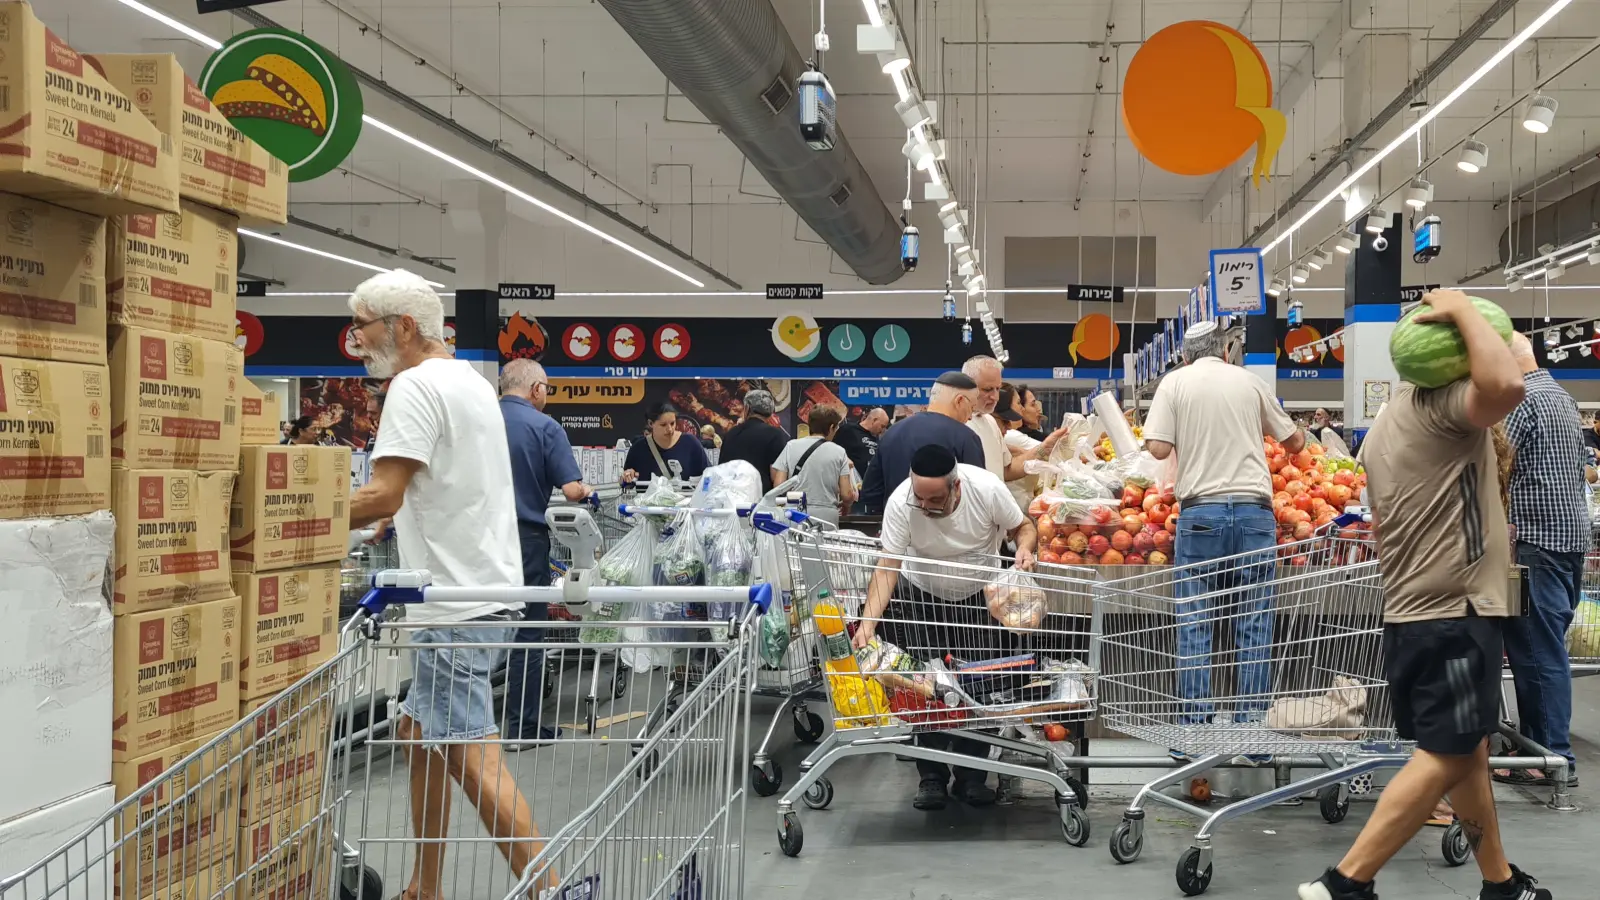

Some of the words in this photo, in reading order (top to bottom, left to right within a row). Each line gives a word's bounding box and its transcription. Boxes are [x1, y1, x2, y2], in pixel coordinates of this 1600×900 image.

[45, 70, 72, 92] מתוק
[77, 82, 101, 102] תירס
[46, 90, 69, 107] Sweet
[72, 98, 88, 114] Corn
[91, 105, 116, 123] Kernels
[105, 94, 131, 113] גרעיני
[183, 110, 202, 126] מתוק
[63, 119, 75, 138] 24
[204, 118, 222, 134] תירס
[182, 125, 199, 140] Sweet
[200, 132, 213, 145] Corn
[193, 148, 202, 164] 24
[127, 239, 147, 255] מתוק
[150, 245, 166, 259] תירס
[169, 250, 189, 264] גרעיני
[126, 255, 145, 267] Sweet
[146, 258, 158, 270] Corn
[159, 262, 177, 275] Kernels
[1219, 262, 1253, 274] רימון
[141, 277, 149, 293] 24
[1231, 276, 1244, 290] 5
[501, 287, 530, 297] האש
[535, 286, 551, 297] על
[768, 287, 796, 298] קפואים
[799, 287, 820, 298] ירקות
[1079, 289, 1112, 299] פירות
[605, 367, 623, 376] טרי
[628, 367, 647, 378] עוף
[139, 382, 159, 396] מתוק
[162, 384, 179, 396] תירס
[181, 387, 200, 398] גרעיני
[562, 386, 590, 398] עוף
[596, 386, 632, 396] נתחי
[848, 386, 891, 398] טריים
[896, 386, 931, 398] דגים
[139, 399, 156, 409] Sweet
[158, 399, 170, 409] Corn
[171, 400, 189, 411] Kernels
[28, 420, 54, 434] גרעיני
[151, 419, 160, 433] 24
[13, 437, 40, 448] Kernels
[265, 494, 280, 507] מתוק
[282, 494, 296, 504] תירס
[297, 493, 313, 503] גרעיני
[264, 508, 278, 517] Sweet
[279, 508, 288, 516] Corn
[138, 523, 157, 538] מתוק
[159, 522, 176, 534] תירס
[178, 521, 196, 532] גרעיני
[273, 525, 280, 538] 24
[138, 538, 154, 549] Sweet
[156, 538, 168, 548] Corn
[169, 536, 187, 547] Kernels
[150, 559, 159, 573] 24
[274, 616, 287, 628] תירס
[288, 613, 304, 625] גרעיני
[257, 620, 272, 634] מתוק
[257, 633, 270, 644] Sweet
[271, 631, 280, 640] Corn
[281, 628, 295, 638] Kernels
[265, 650, 272, 663] 24
[159, 661, 175, 675] תירס
[177, 656, 196, 671] גרעיני
[138, 666, 156, 684] מתוק
[138, 682, 154, 695] Sweet
[155, 680, 166, 691] Corn
[168, 675, 186, 688] Kernels
[148, 701, 157, 717] 24
